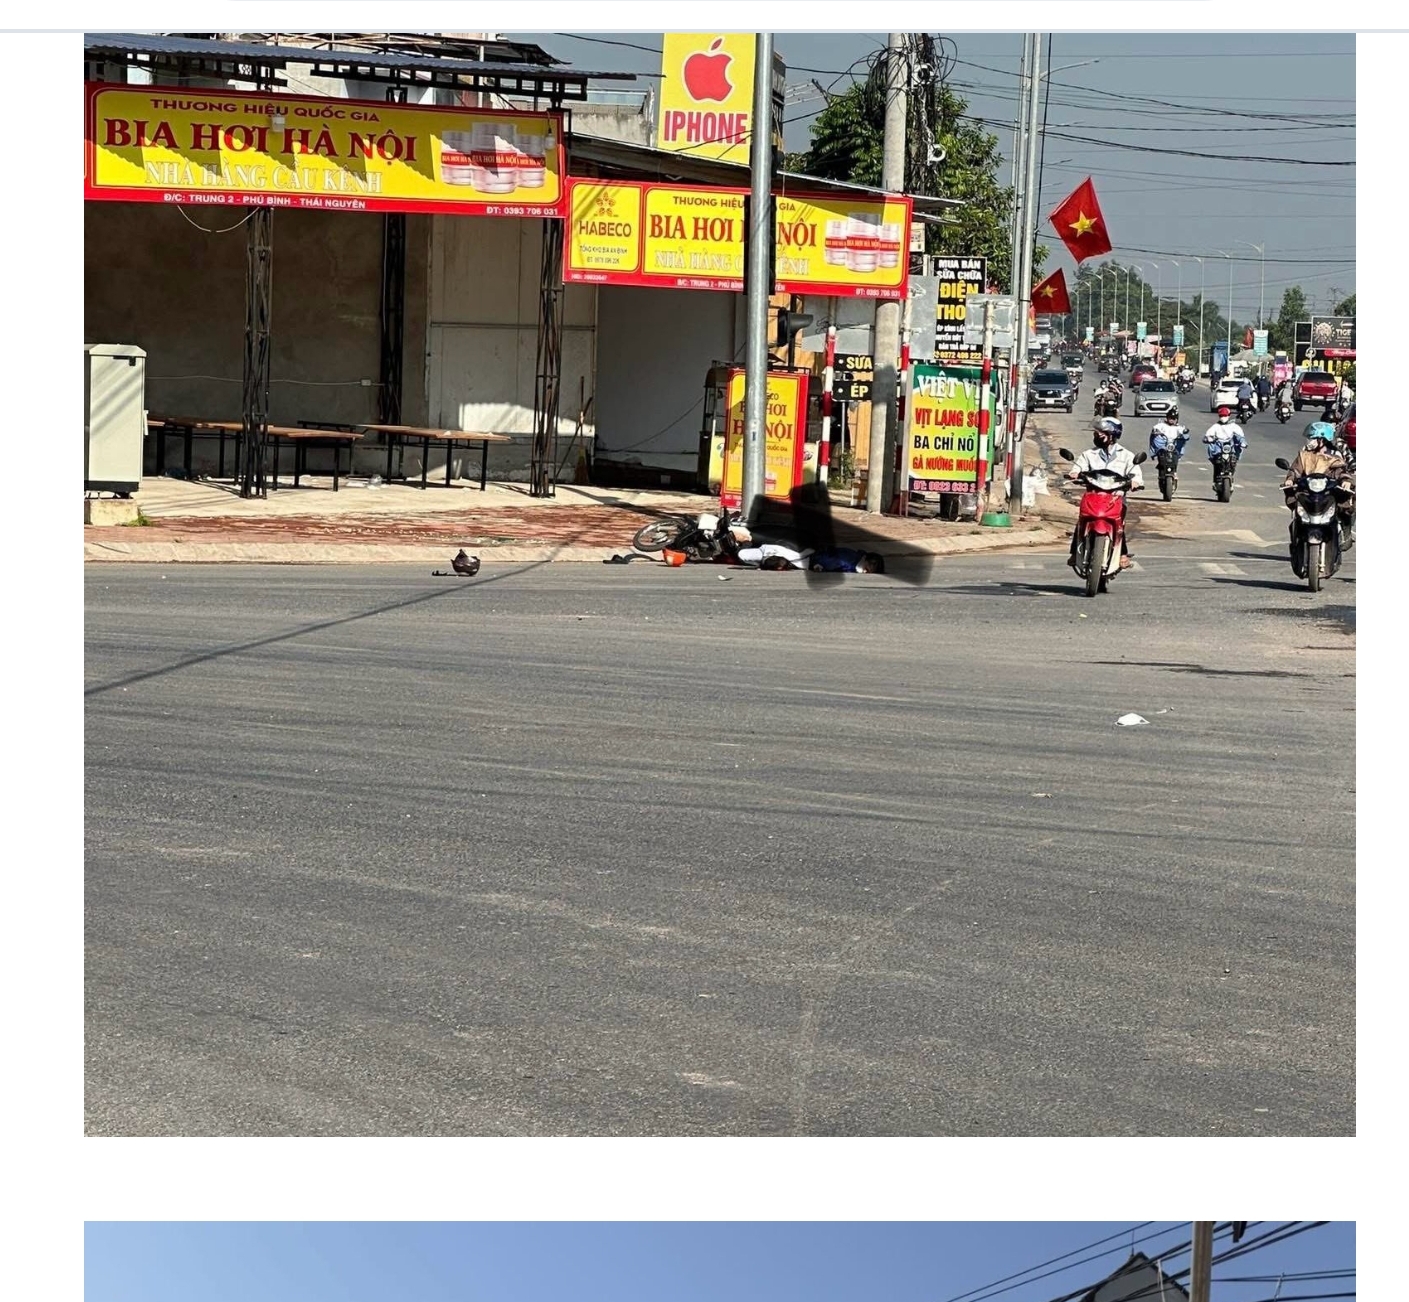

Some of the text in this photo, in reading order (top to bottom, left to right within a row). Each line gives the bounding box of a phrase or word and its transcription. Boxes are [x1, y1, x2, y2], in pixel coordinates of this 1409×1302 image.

[294, 105, 346, 119] QUỐC
[350, 110, 380, 122] GIA
[664, 110, 748, 144] IPHONE
[104, 118, 417, 166] BIA HƠI HÀ NỘI
[146, 157, 197, 186] NHÀ
[202, 158, 266, 188] HÀNG
[323, 163, 383, 194] KÊNH
[189, 194, 225, 204] TRUNG
[227, 196, 234, 204] 2
[300, 196, 322, 207] THÁI
[779, 202, 796, 211] GIA
[579, 220, 632, 237] HABECO
[649, 214, 687, 240] BIA
[692, 216, 734, 243] HƠI
[777, 218, 817, 250] NỘI
[938, 258, 981, 270] MUA BÁN
[940, 280, 978, 302] ĐIỆN
[936, 304, 966, 320] THO
[850, 382, 869, 398] ÉP
[917, 370, 981, 406] VIỆT VỊ
[915, 407, 932, 429] VỊT
[934, 408, 964, 430] LẠNG
[914, 435, 930, 449] BA
[934, 432, 955, 451] CHỈ
